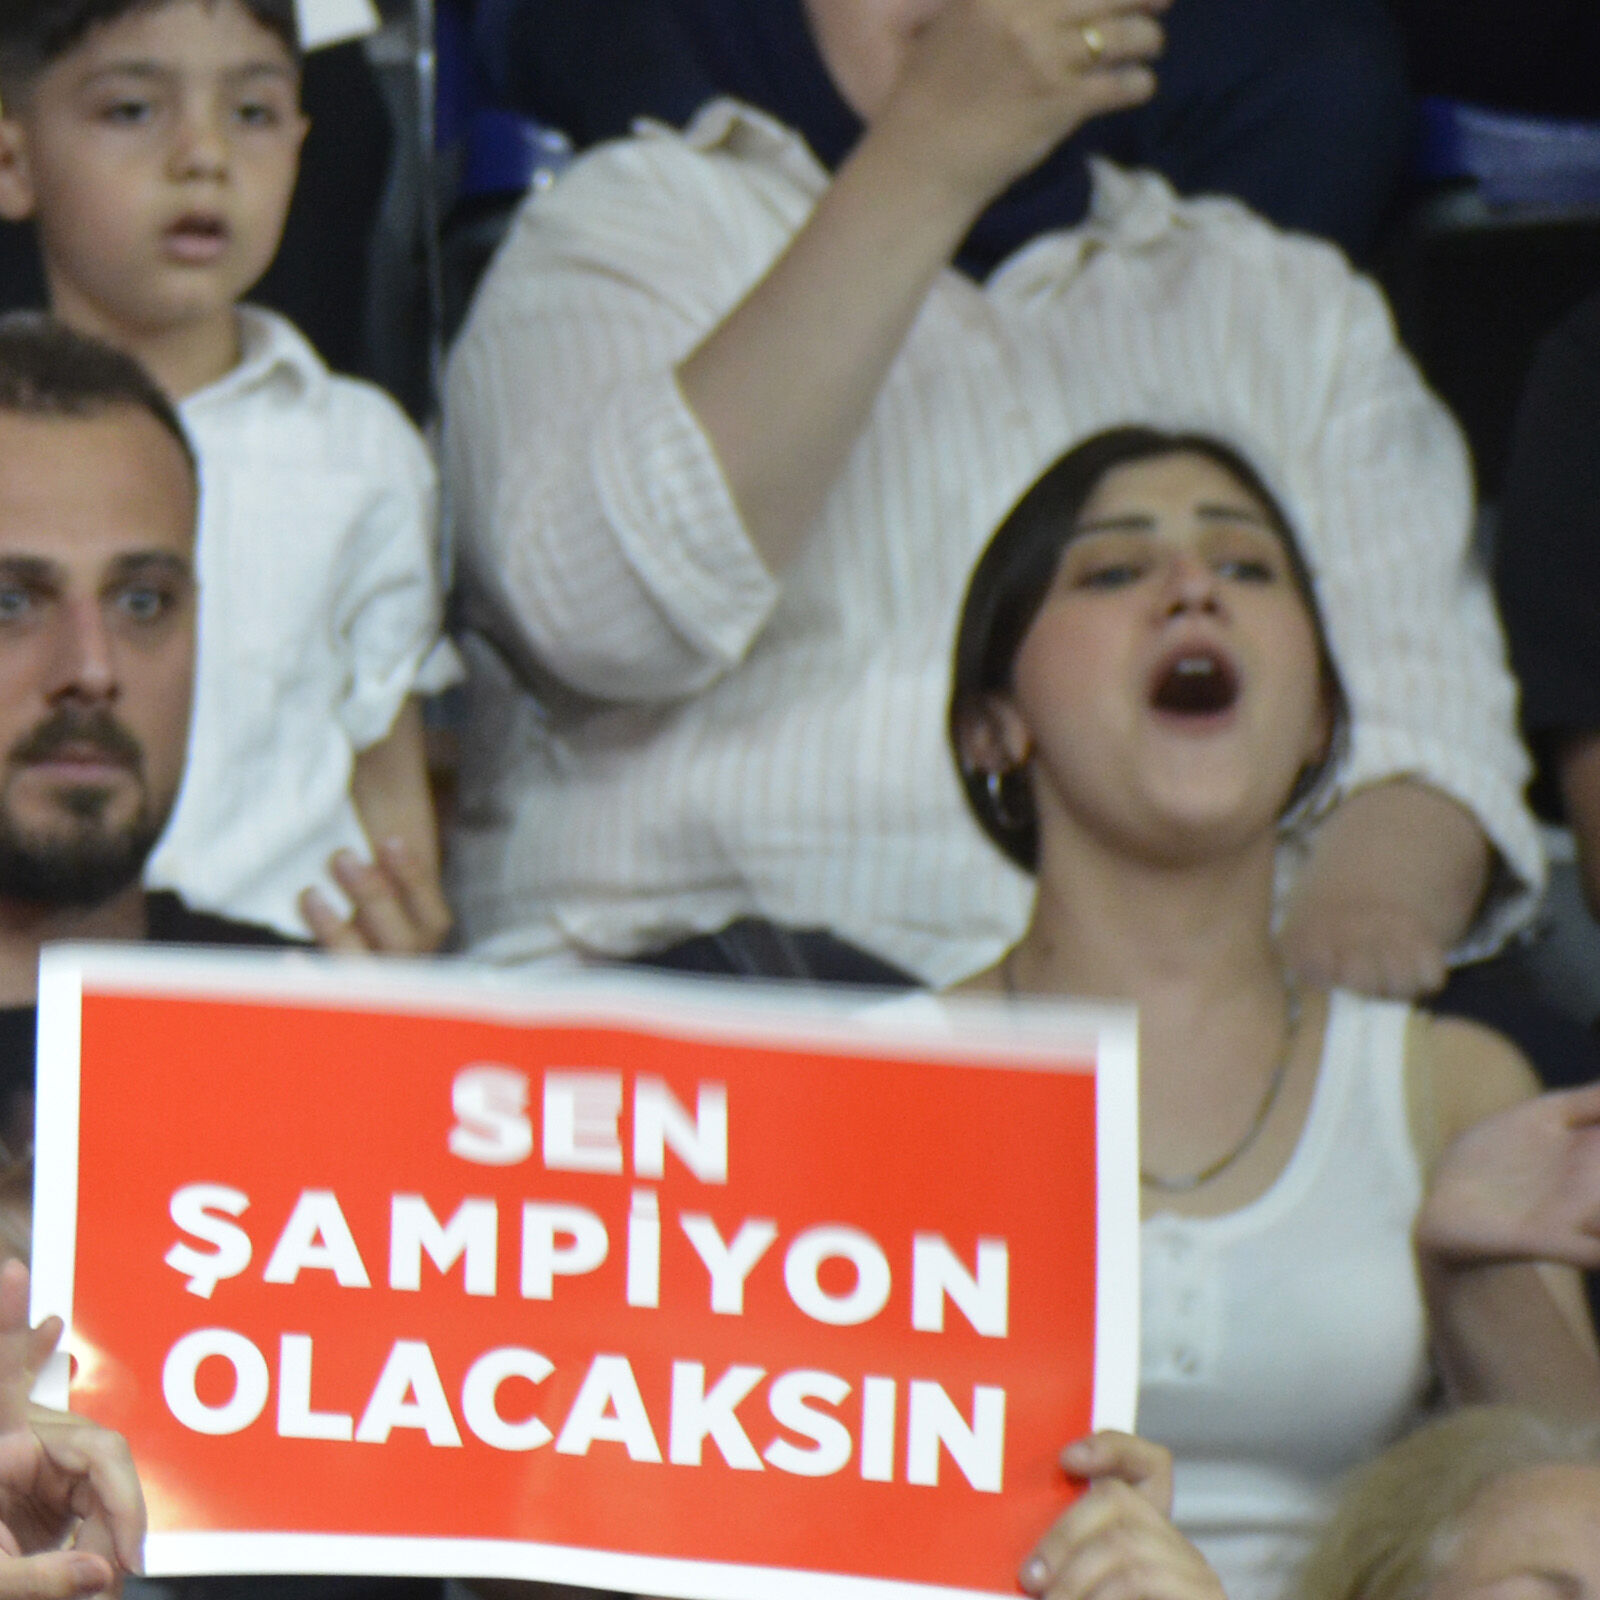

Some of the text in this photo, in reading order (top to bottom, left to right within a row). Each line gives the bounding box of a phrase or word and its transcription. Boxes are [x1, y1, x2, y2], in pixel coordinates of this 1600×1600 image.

[448, 1064, 729, 1184] SEN
[164, 1183, 1010, 1339] ŞAMPİYON
[162, 1327, 1007, 1494] OLACAKSIN
